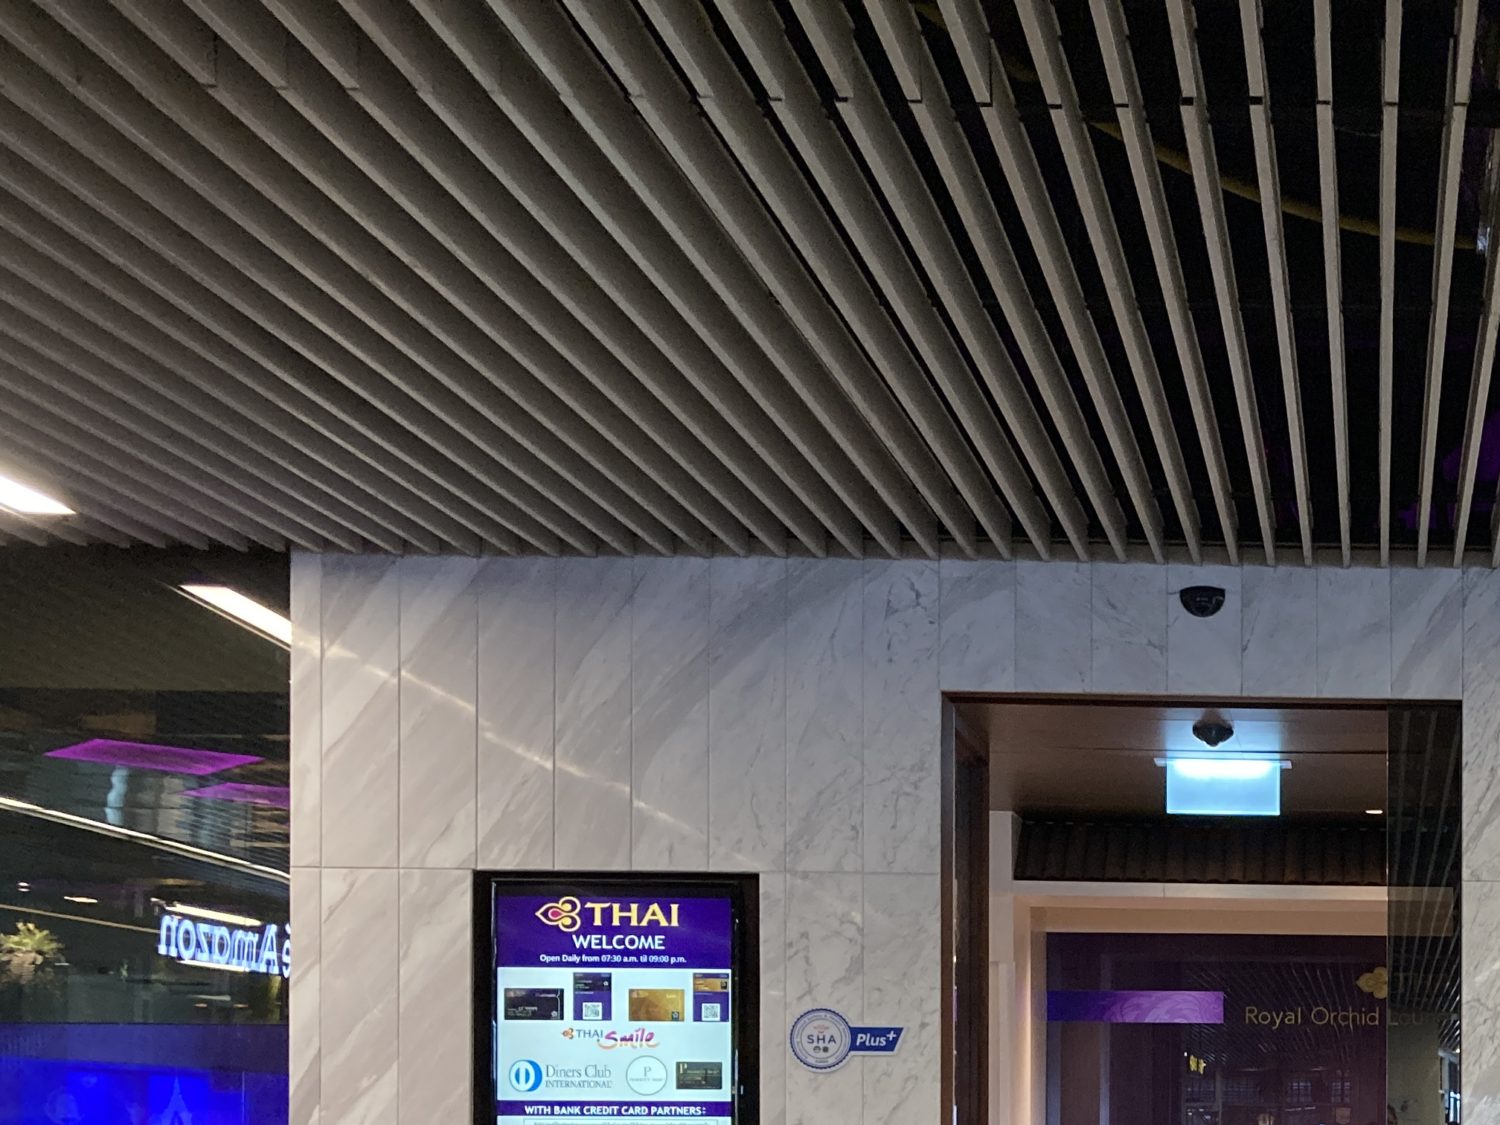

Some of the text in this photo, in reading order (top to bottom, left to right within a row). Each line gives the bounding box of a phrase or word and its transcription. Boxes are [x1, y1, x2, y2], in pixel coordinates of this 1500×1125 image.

[584, 902, 680, 927] THAI
[572, 934, 665, 950] WELCOME
[539, 954, 560, 963] Open
[562, 954, 581, 964] Daily
[582, 954, 599, 962] from
[601, 954, 621, 962] 07:30
[649, 955, 669, 963] 09:00
[670, 956, 687, 964] p.m.
[1245, 1006, 1301, 1030] Royal
[1311, 1006, 1380, 1026] Orchid
[576, 1029, 604, 1039] THAI
[807, 1034, 837, 1044] SHA
[545, 1063, 612, 1078] Diners Club
[545, 1080, 612, 1089] INTERNATIONAL
[524, 1105, 551, 1115] WITH
[553, 1105, 581, 1115] BANK
[584, 1105, 619, 1115] CREDIT
[621, 1106, 649, 1115] CARD
